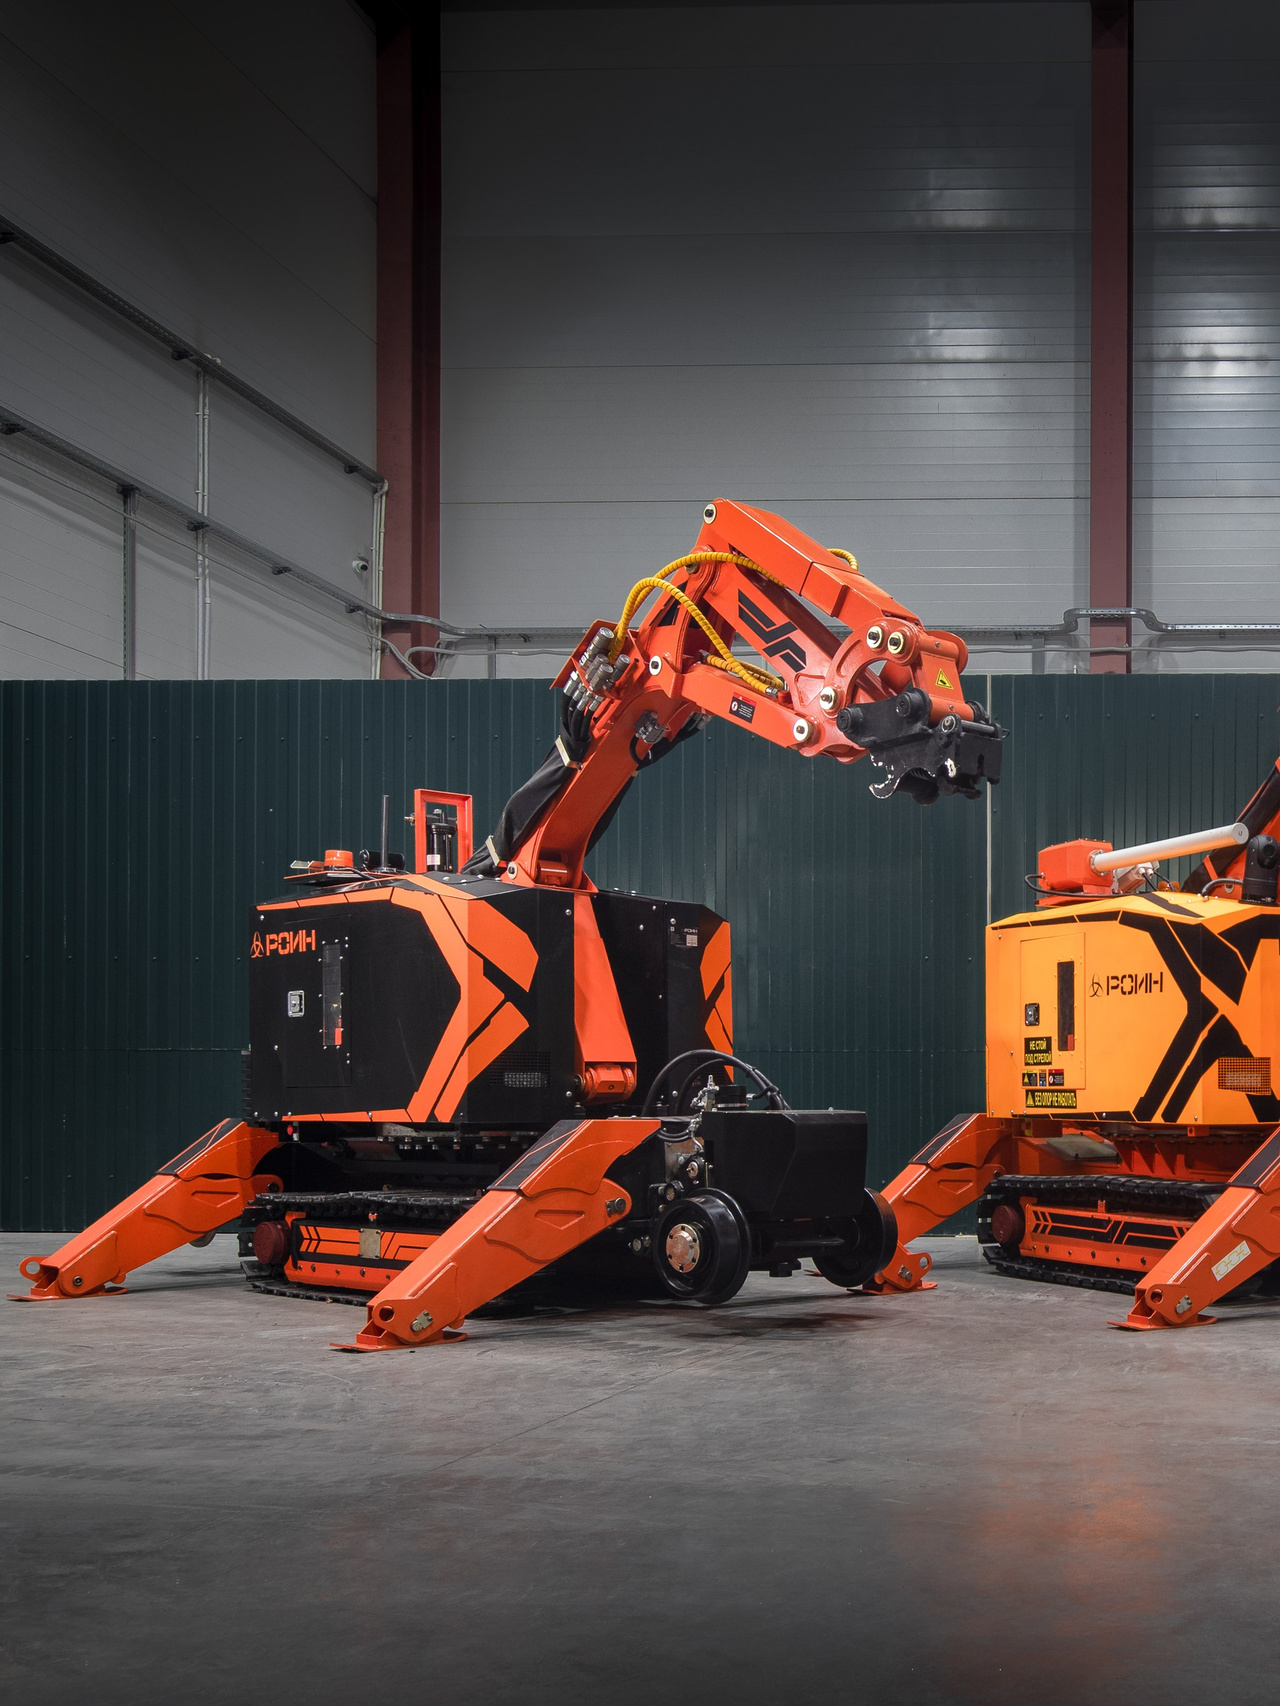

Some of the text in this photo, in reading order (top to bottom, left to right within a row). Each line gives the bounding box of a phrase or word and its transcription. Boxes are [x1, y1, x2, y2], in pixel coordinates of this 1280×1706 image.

[265, 929, 316, 956] РОИН
[1106, 971, 1163, 996] РОИН
[1029, 1041, 1035, 1050] НЕ
